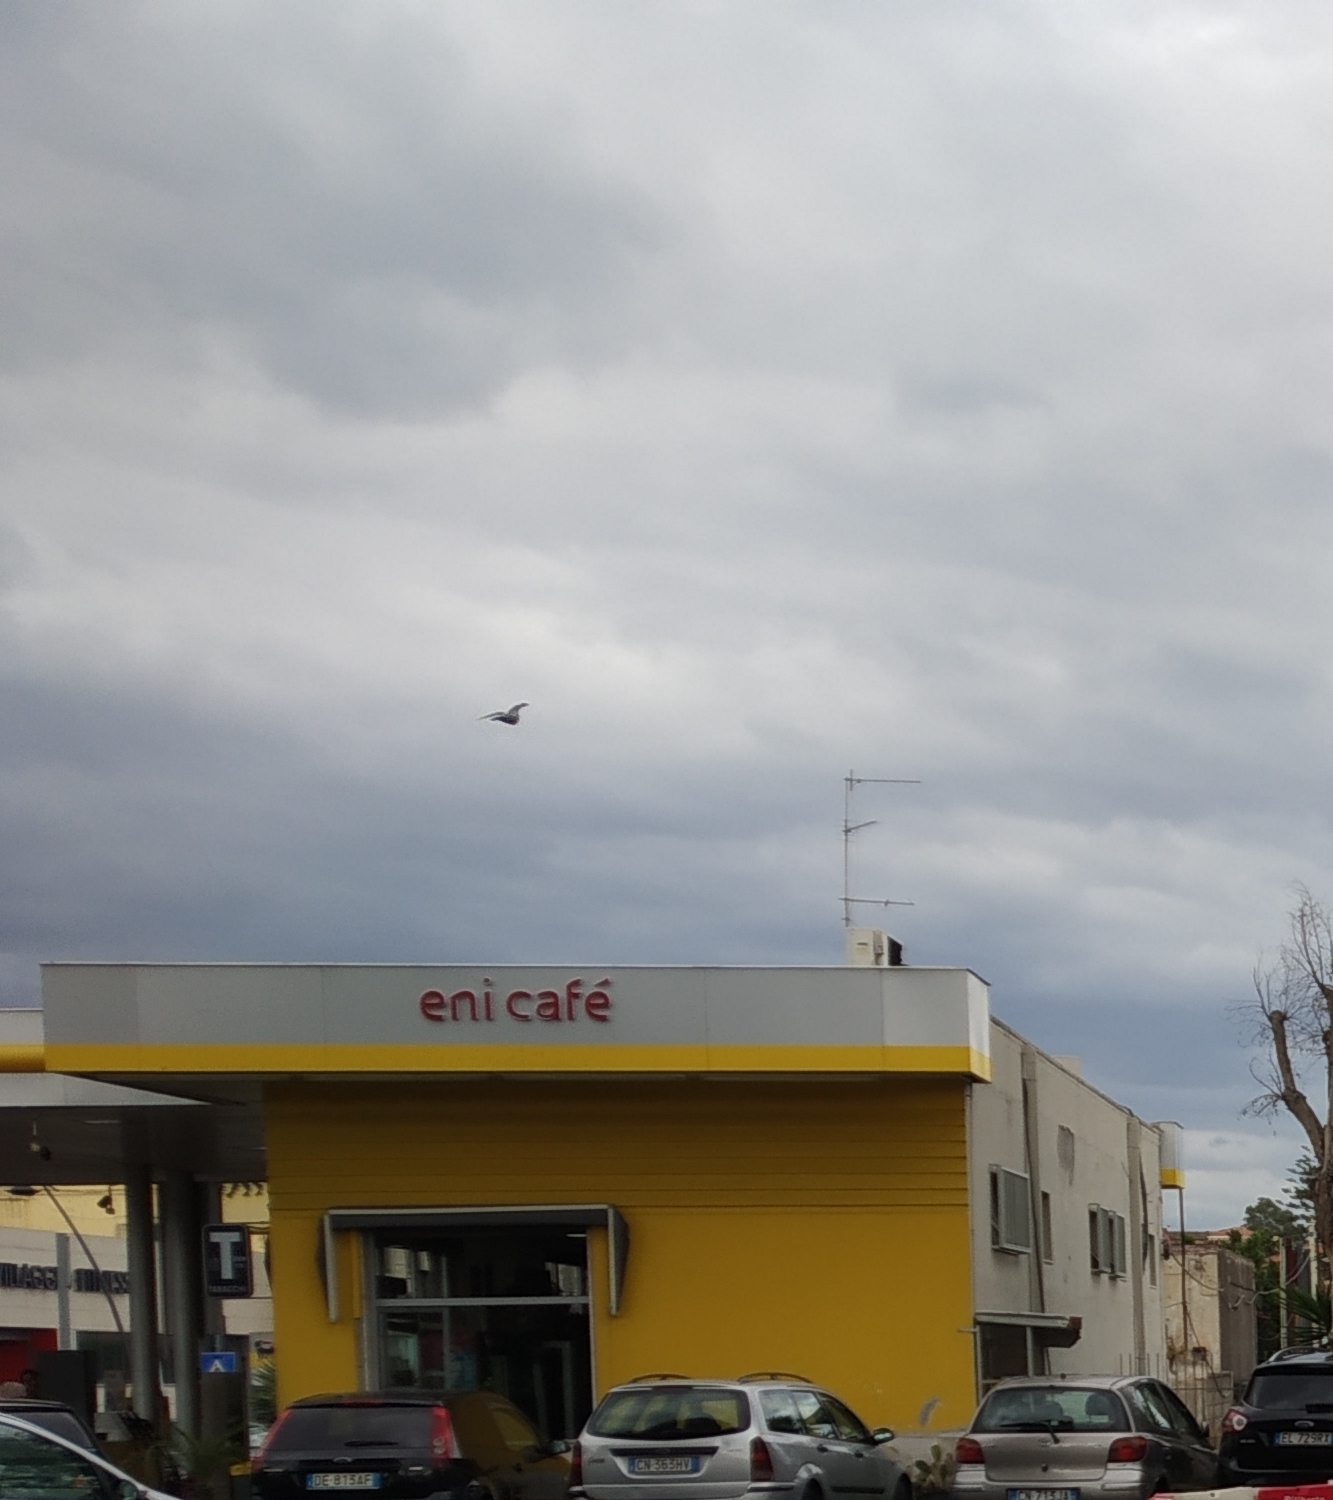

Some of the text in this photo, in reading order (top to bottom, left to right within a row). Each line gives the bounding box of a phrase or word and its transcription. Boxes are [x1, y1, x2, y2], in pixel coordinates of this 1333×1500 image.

[420, 977, 612, 1021] eni café
[209, 1231, 241, 1280] T
